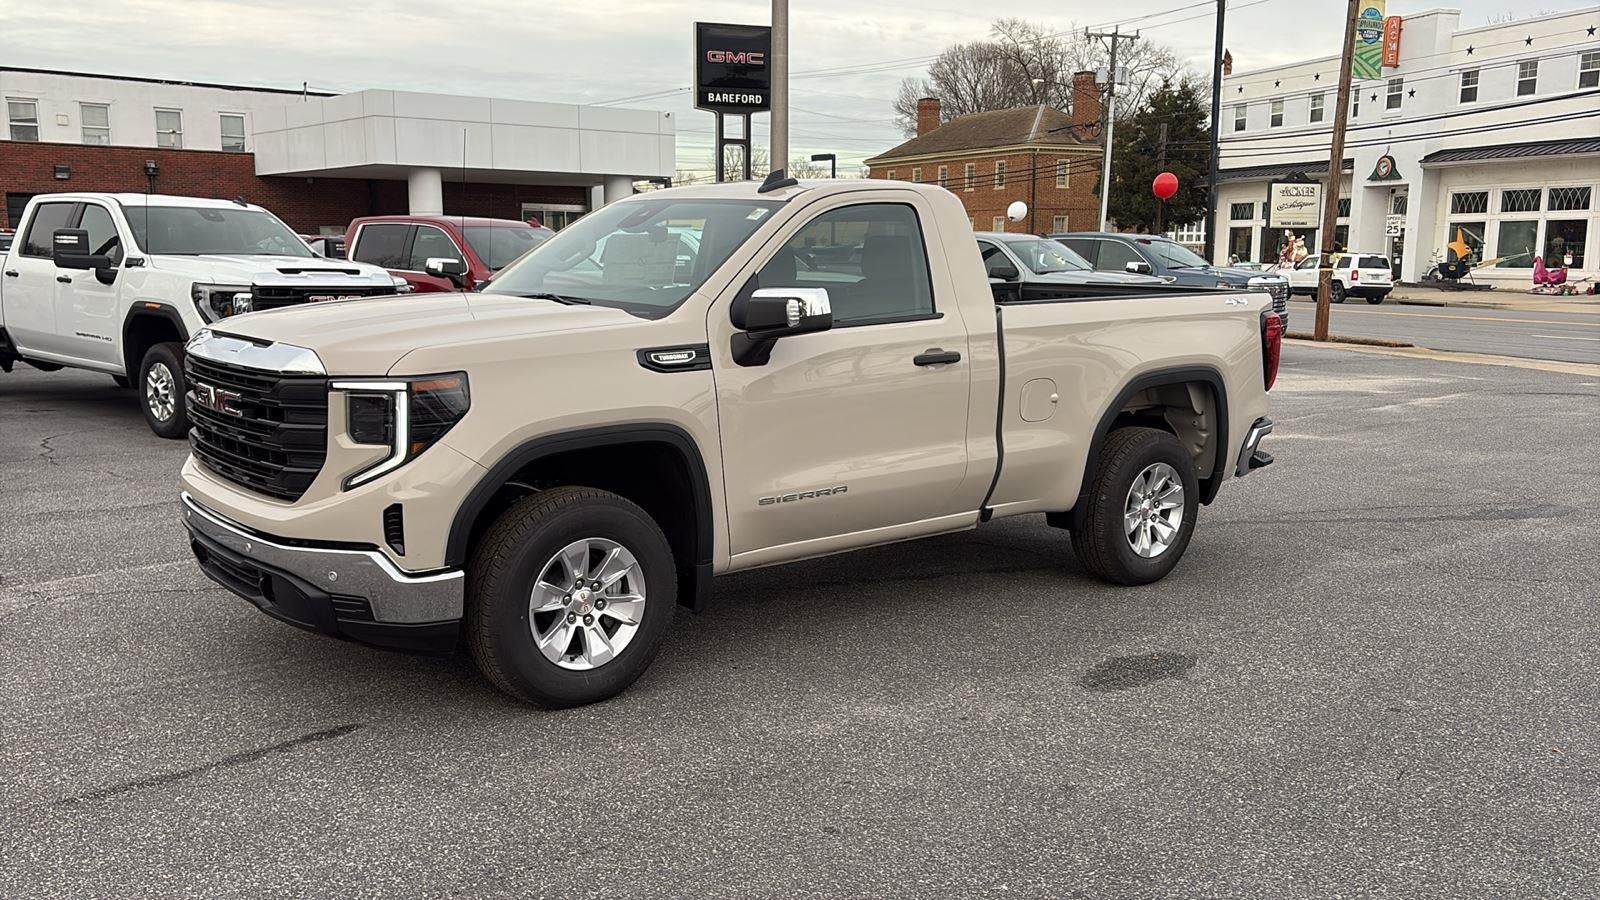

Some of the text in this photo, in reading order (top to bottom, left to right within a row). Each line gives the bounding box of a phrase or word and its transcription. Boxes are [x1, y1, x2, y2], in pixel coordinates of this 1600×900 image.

[1388, 20, 1397, 63] ACME
[706, 50, 764, 65] GMC
[708, 92, 762, 104] BAREFORD
[1386, 225, 1400, 234] 25
[658, 353, 689, 361] TURBOMAX
[194, 382, 243, 418] GMC
[758, 485, 848, 506] SIERRA
